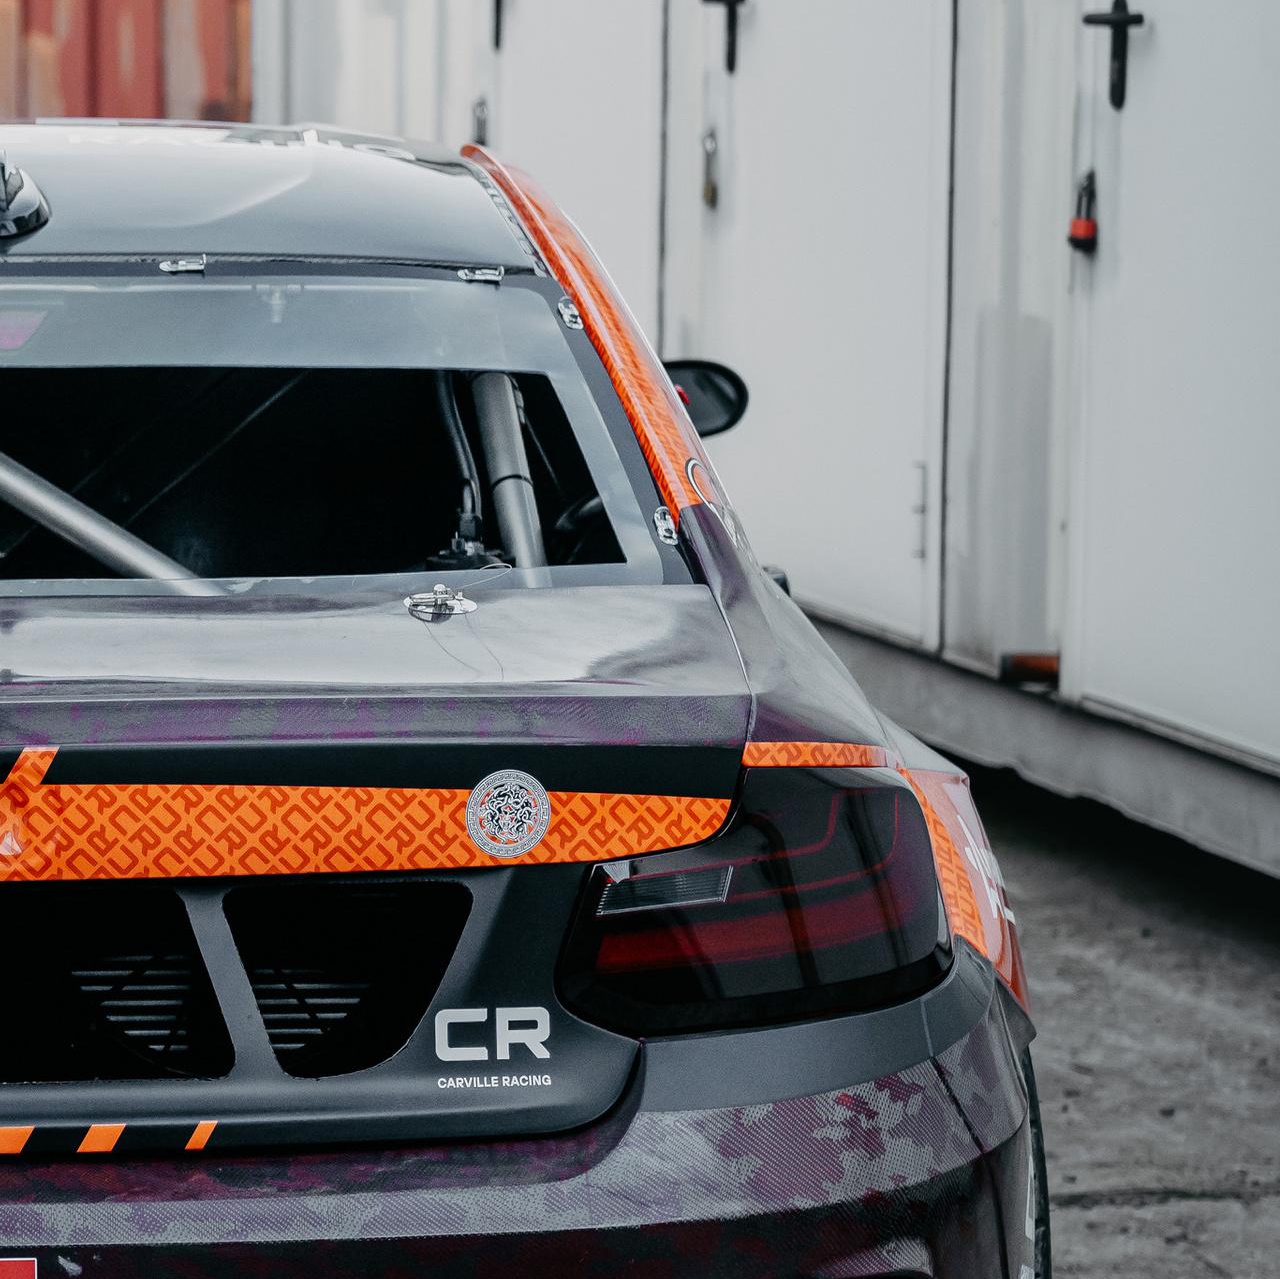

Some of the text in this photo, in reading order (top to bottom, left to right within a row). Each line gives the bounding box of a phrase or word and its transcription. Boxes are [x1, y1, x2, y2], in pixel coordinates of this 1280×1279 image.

[435, 1006, 551, 1062] CR
[437, 1074, 552, 1089] CARVILLE RACING
